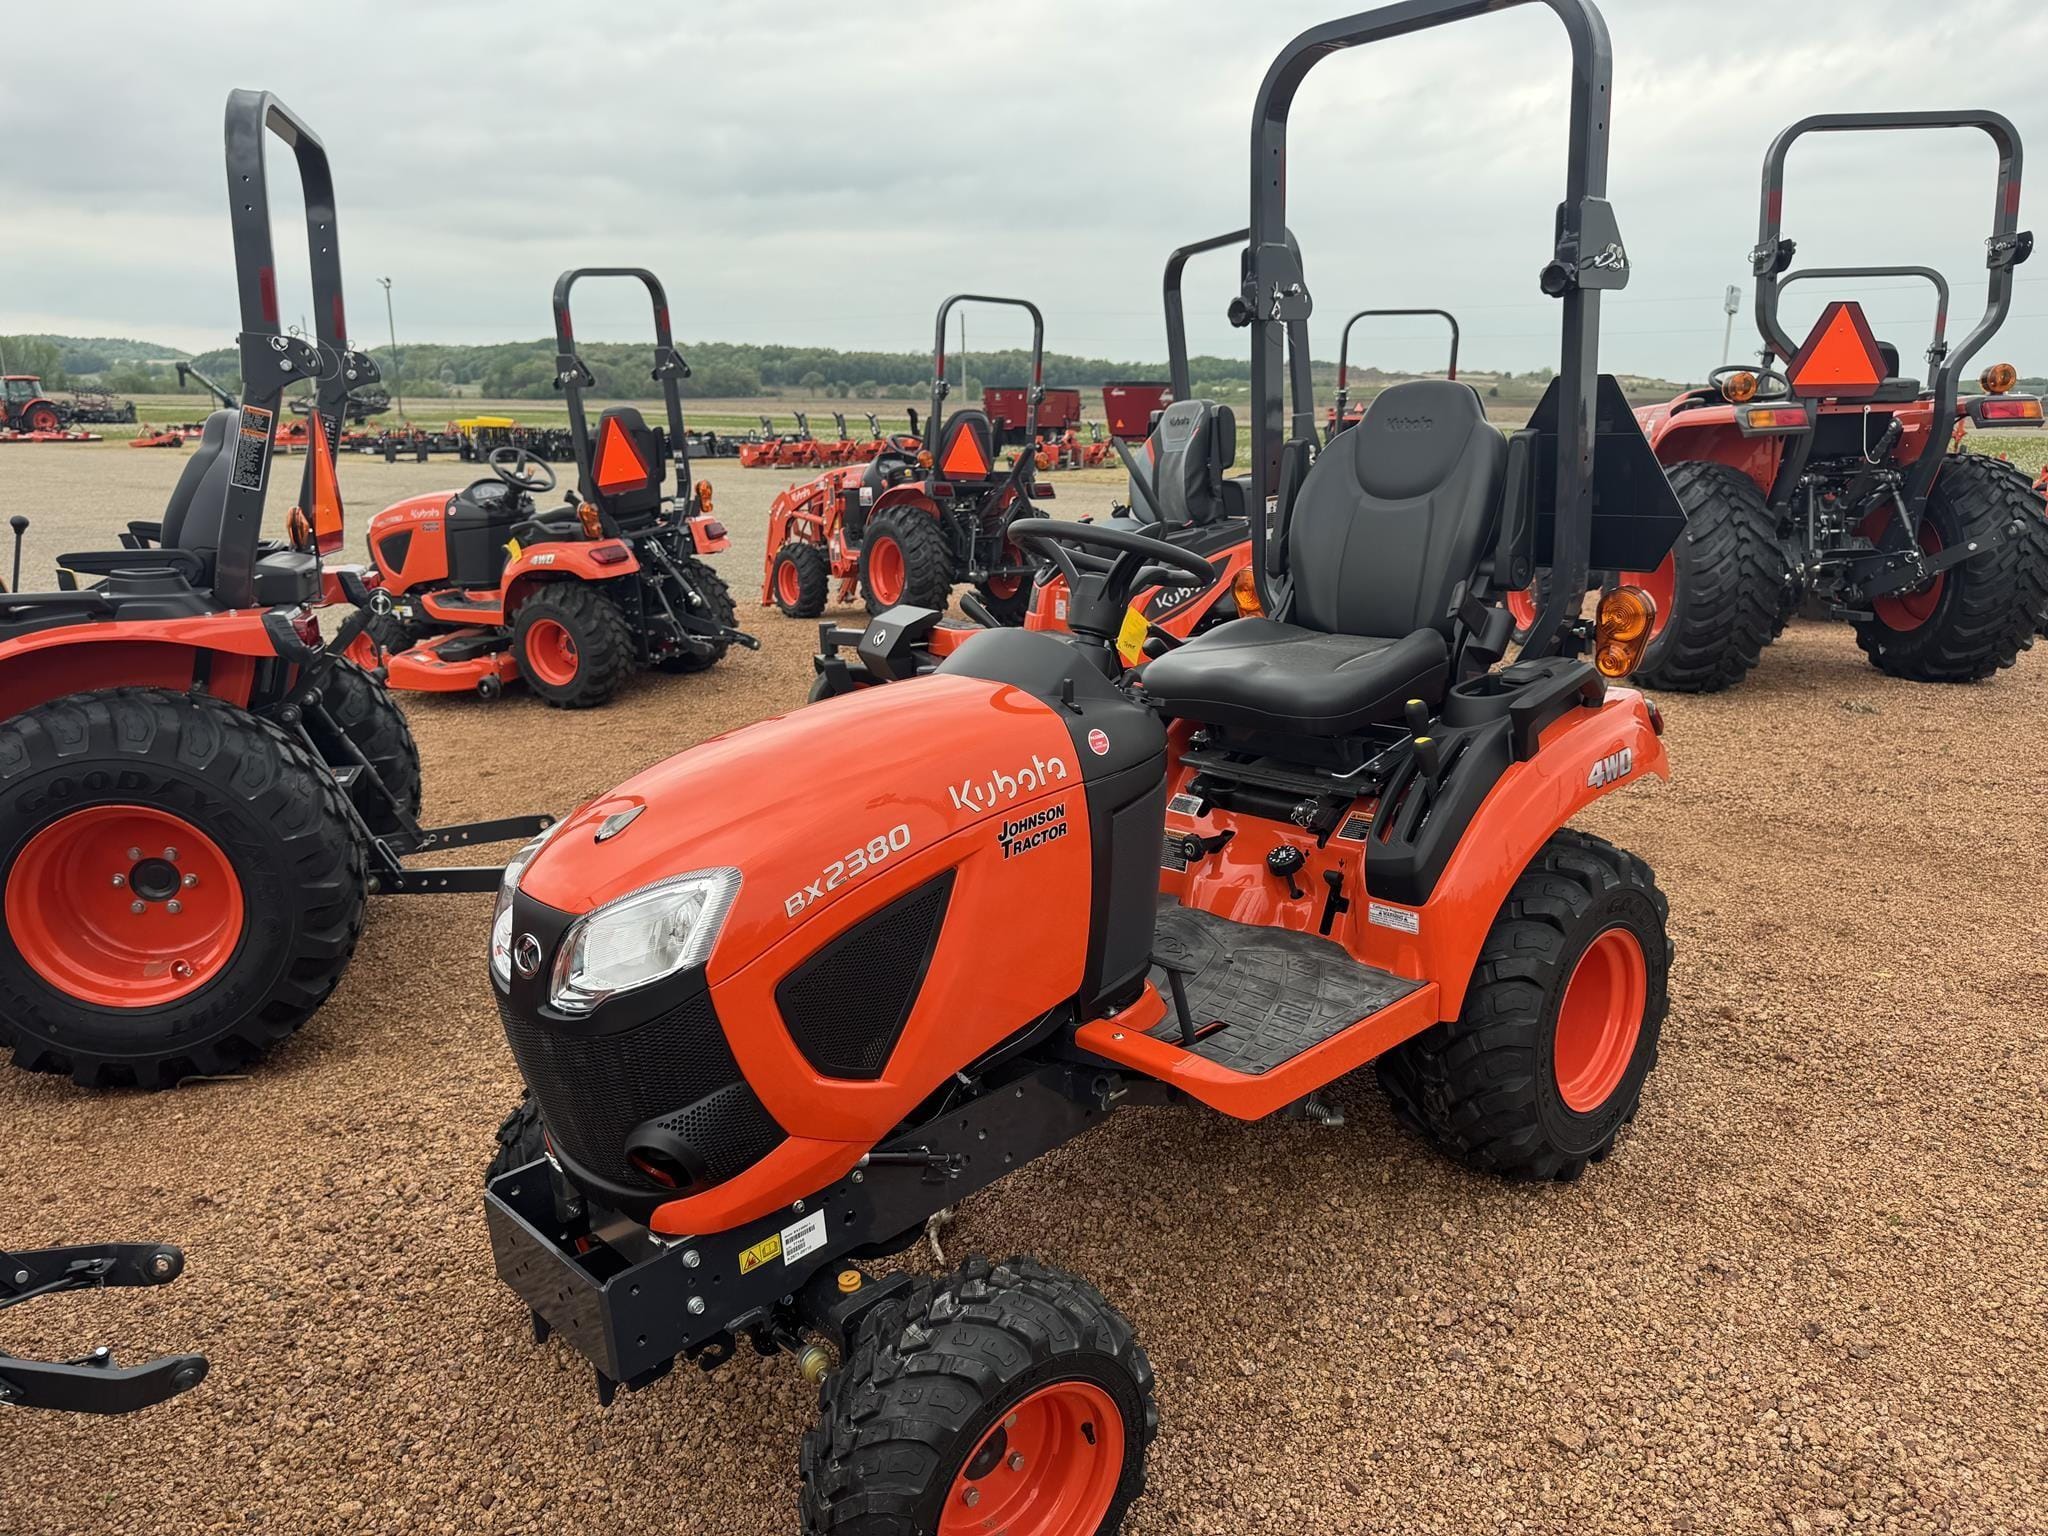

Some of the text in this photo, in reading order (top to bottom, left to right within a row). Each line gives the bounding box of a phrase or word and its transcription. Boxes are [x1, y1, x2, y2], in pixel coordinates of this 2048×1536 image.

[1169, 416, 1190, 427] Kubota
[1384, 415, 1433, 432] Kubota
[530, 553, 556, 566] 4WD
[948, 754, 1068, 813] Kubota
[1587, 746, 1632, 789] 4WD
[997, 803, 1065, 842] JOHNSON
[1001, 822, 1068, 860] TRACTOR
[784, 823, 911, 918] BX2380
